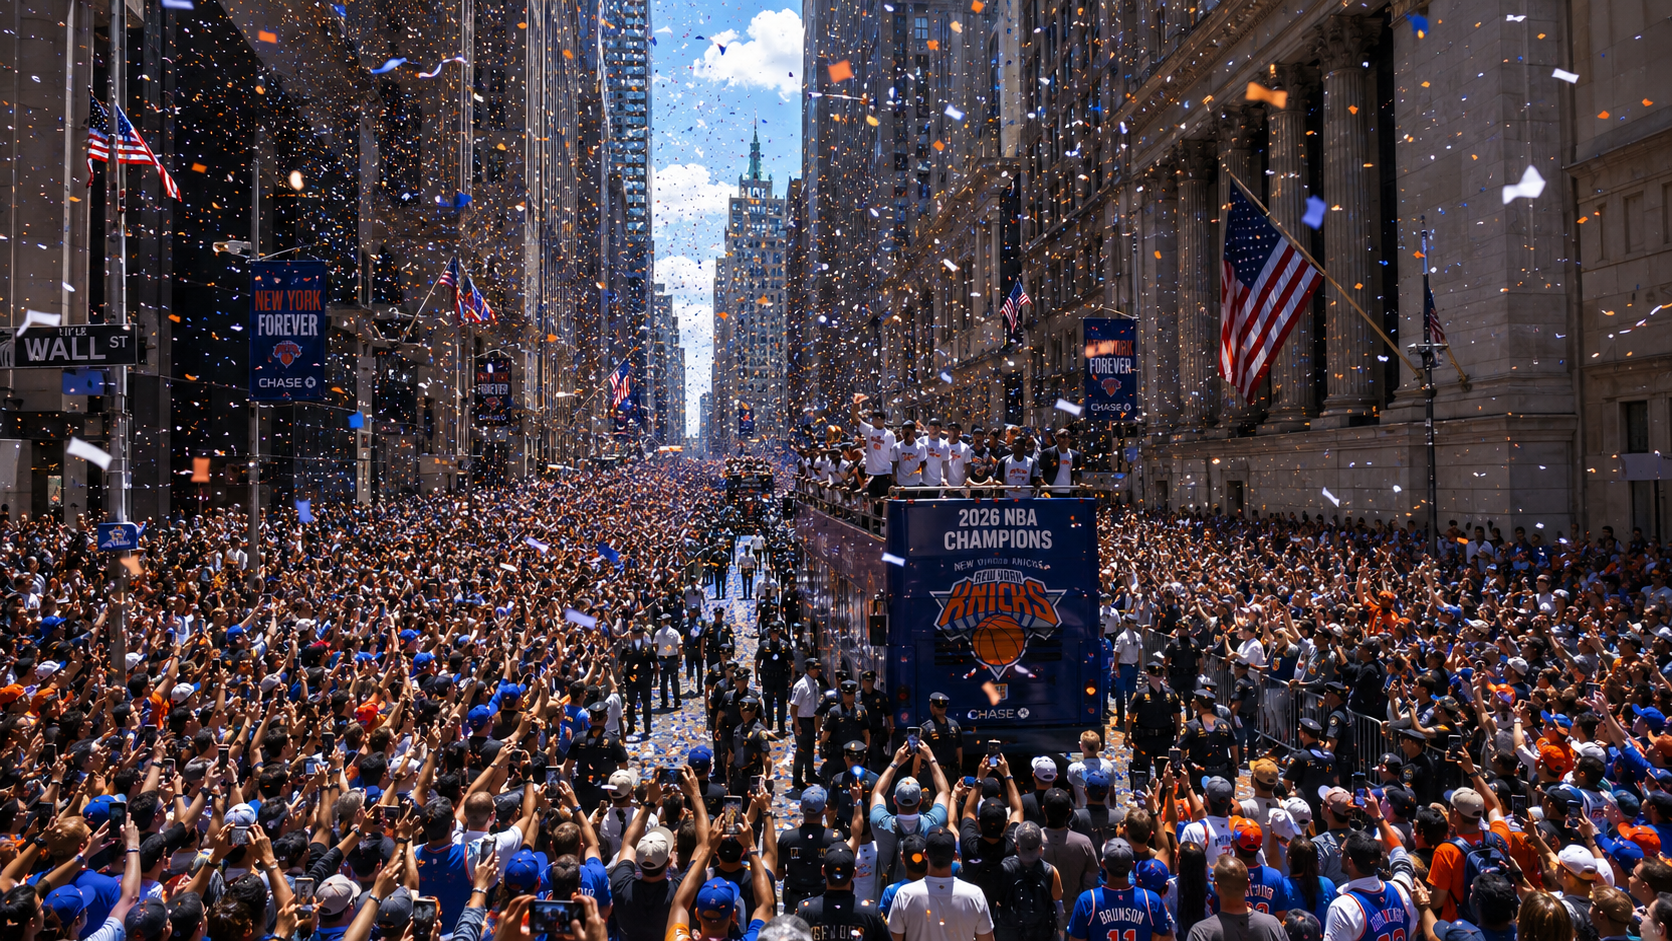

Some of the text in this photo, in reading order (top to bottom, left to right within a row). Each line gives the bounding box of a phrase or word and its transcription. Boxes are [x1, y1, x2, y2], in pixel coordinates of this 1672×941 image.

[255, 290, 322, 311] NEW YORK
[258, 314, 318, 336] FOREVER
[24, 335, 128, 361] WALL ST
[1089, 357, 1131, 374] FOREVER
[258, 378, 302, 388] CHASE
[1090, 403, 1122, 411] CHASE
[958, 508, 1038, 527] 2026 NBA
[944, 529, 1053, 550] CHAMPIONS
[939, 580, 1058, 627] KNICKS
[967, 708, 1015, 720] CHASE
[1098, 907, 1145, 925] BRUNSON
